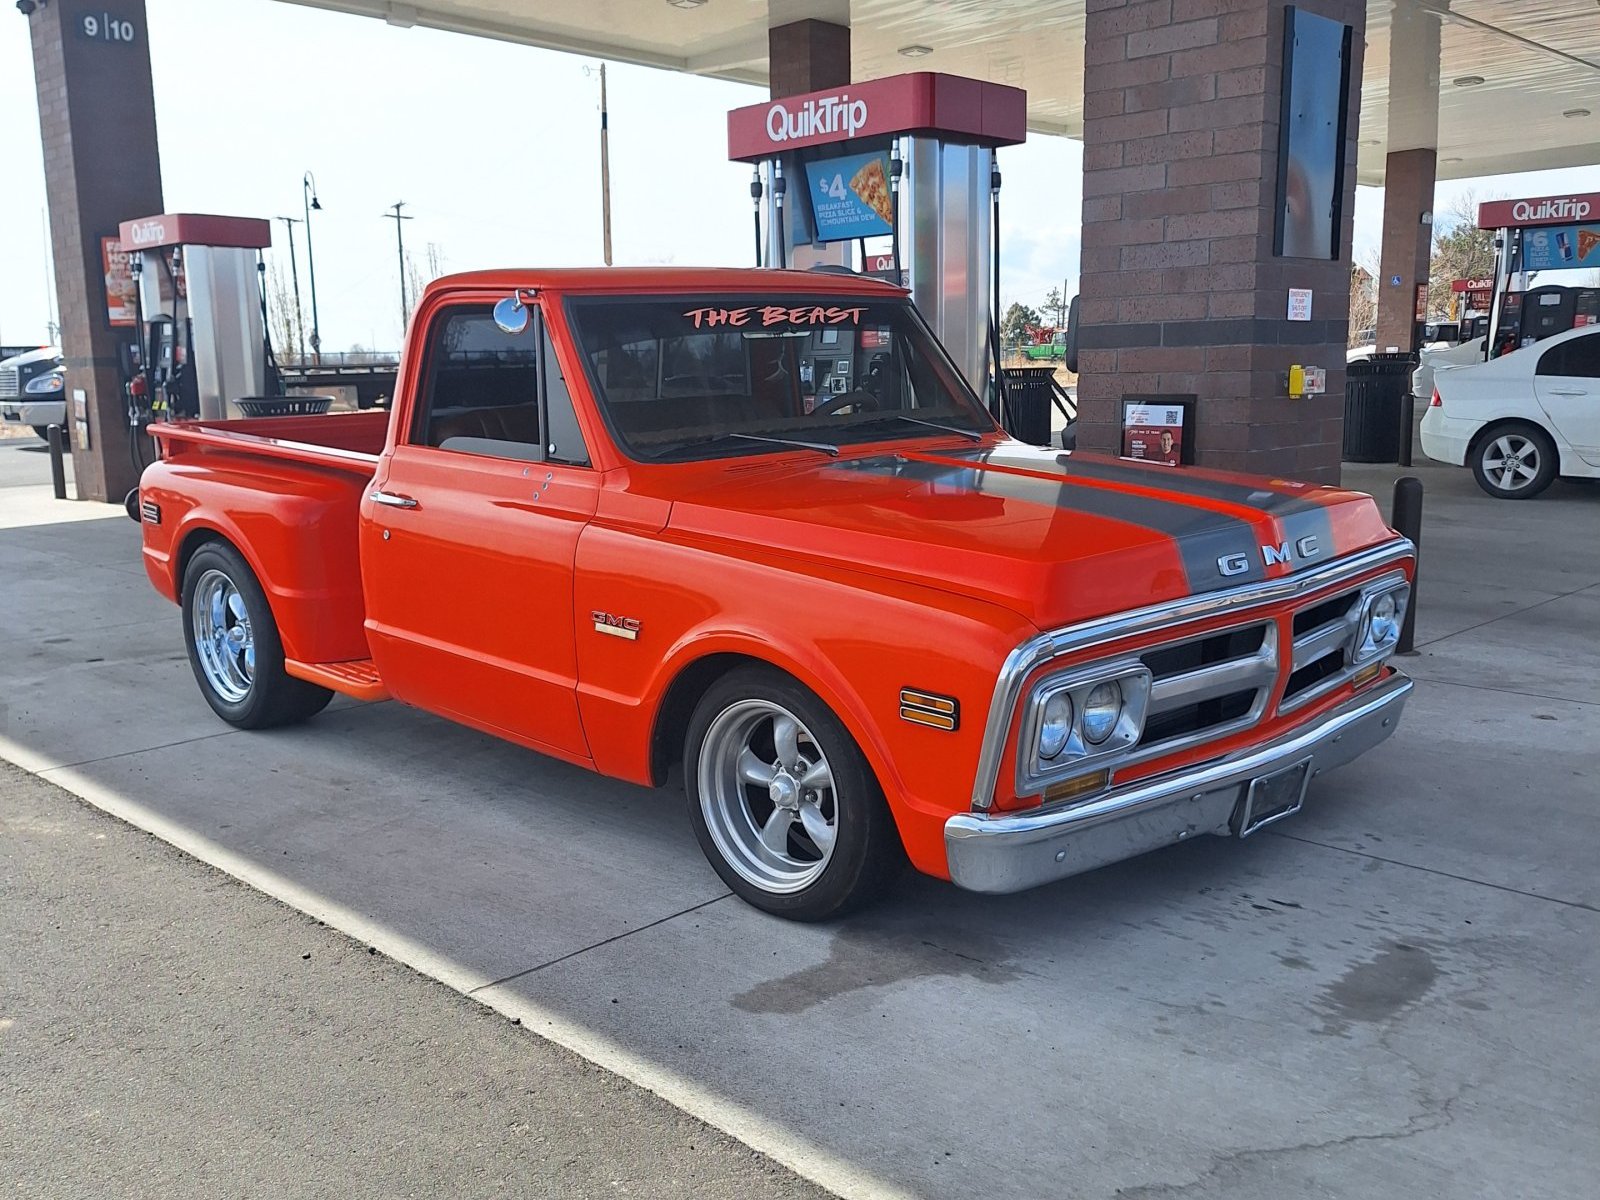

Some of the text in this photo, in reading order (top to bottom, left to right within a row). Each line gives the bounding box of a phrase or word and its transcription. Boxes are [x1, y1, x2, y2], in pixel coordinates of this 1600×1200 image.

[766, 95, 868, 142] QuikTrip
[820, 174, 847, 201] $4
[817, 201, 855, 212] BREAKFAST
[819, 210, 837, 219] PIZZA
[1512, 198, 1591, 221] QuikTrip
[1467, 280, 1493, 289] QuikTr
[683, 306, 869, 329] THE BEAST
[1217, 534, 1320, 577] GMC
[591, 610, 640, 631] GMC
